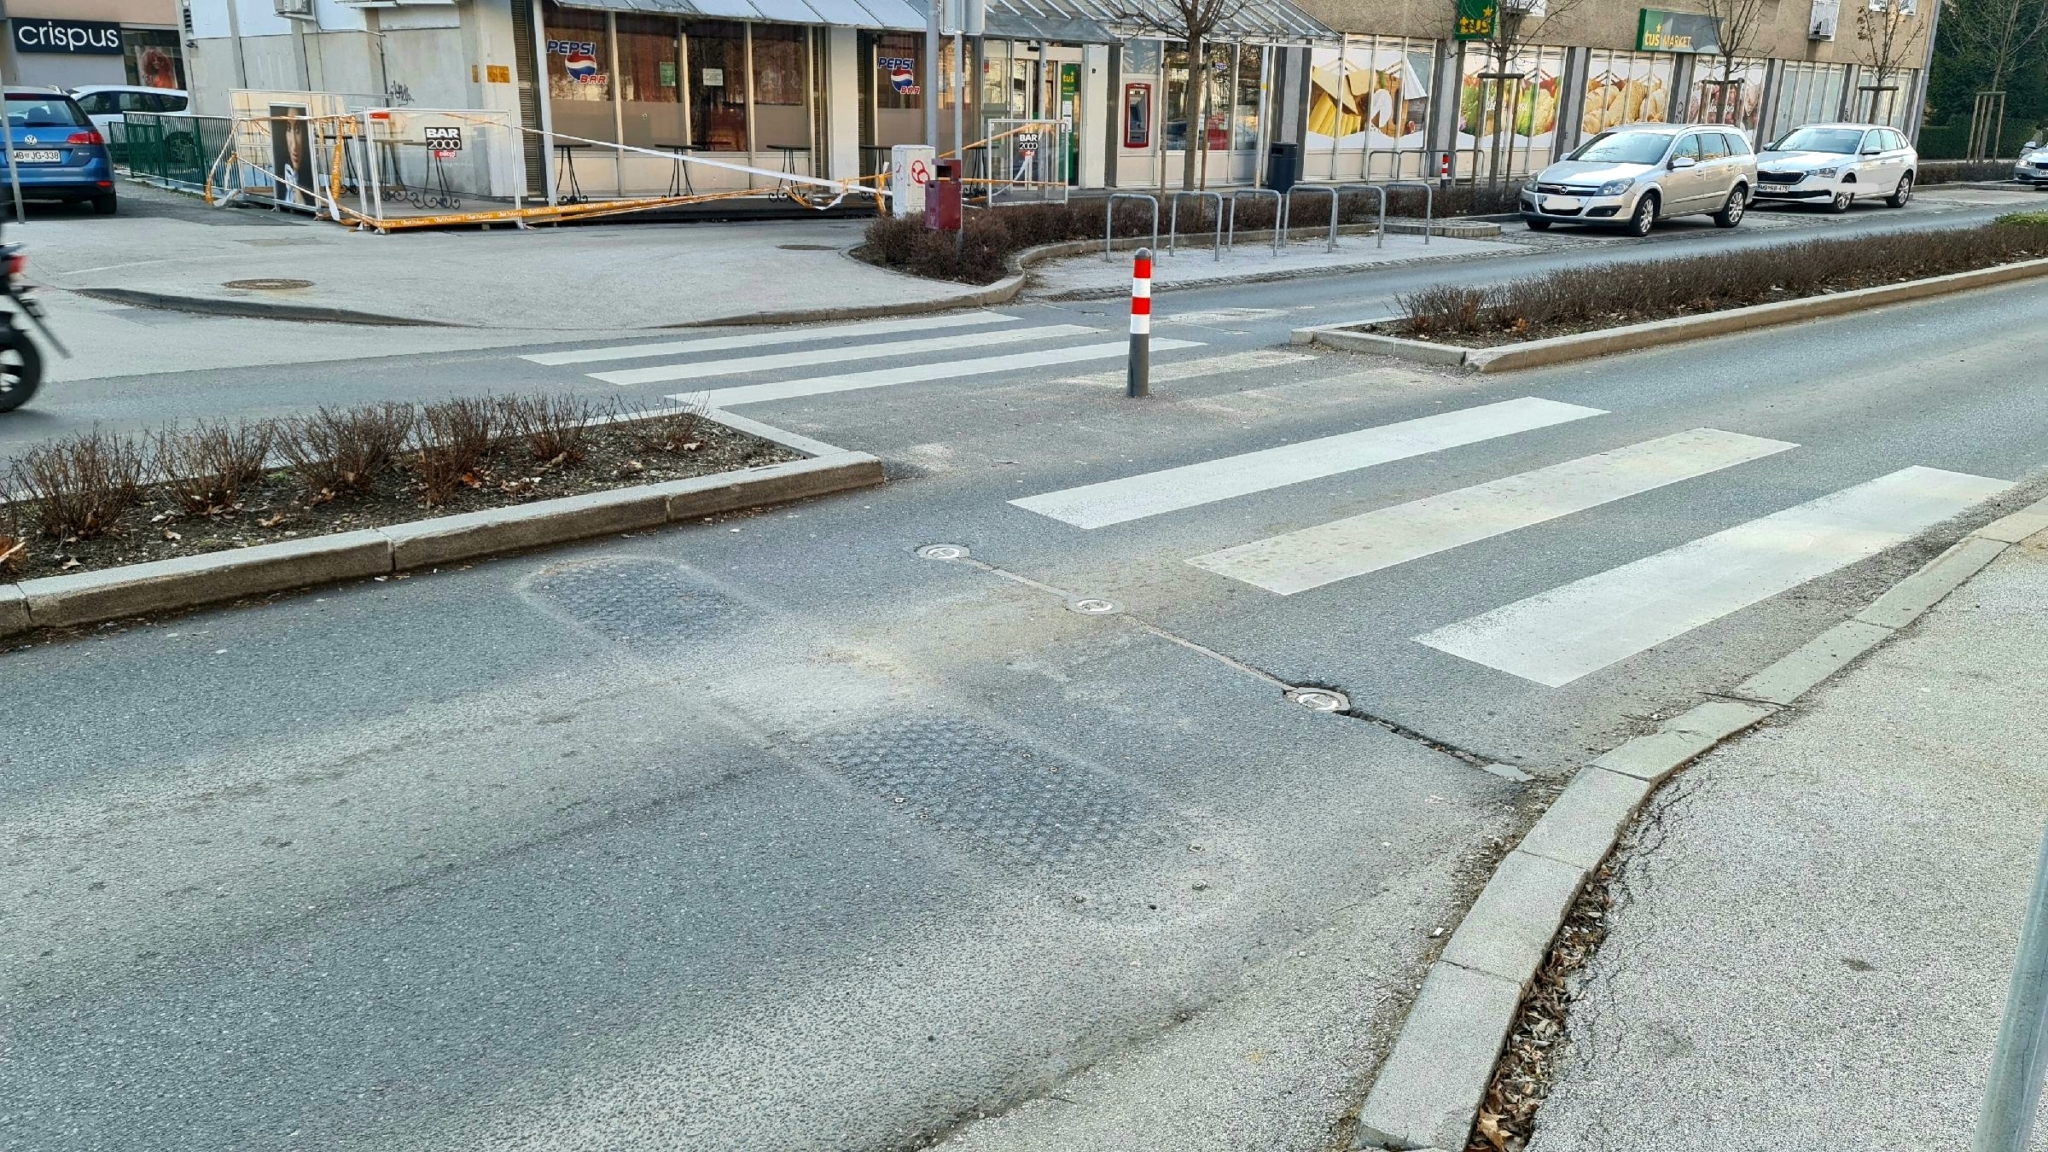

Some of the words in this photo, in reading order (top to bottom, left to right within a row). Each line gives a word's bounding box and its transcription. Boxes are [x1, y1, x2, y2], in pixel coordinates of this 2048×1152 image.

[19, 21, 119, 51] crispus
[1663, 35, 1692, 47] MARKET
[546, 40, 596, 56] PEPSI
[878, 57, 914, 70] PEPSI
[580, 74, 606, 84] BAR
[900, 86, 920, 94] BAR
[426, 128, 460, 138] BAR
[427, 139, 461, 149] 2000
